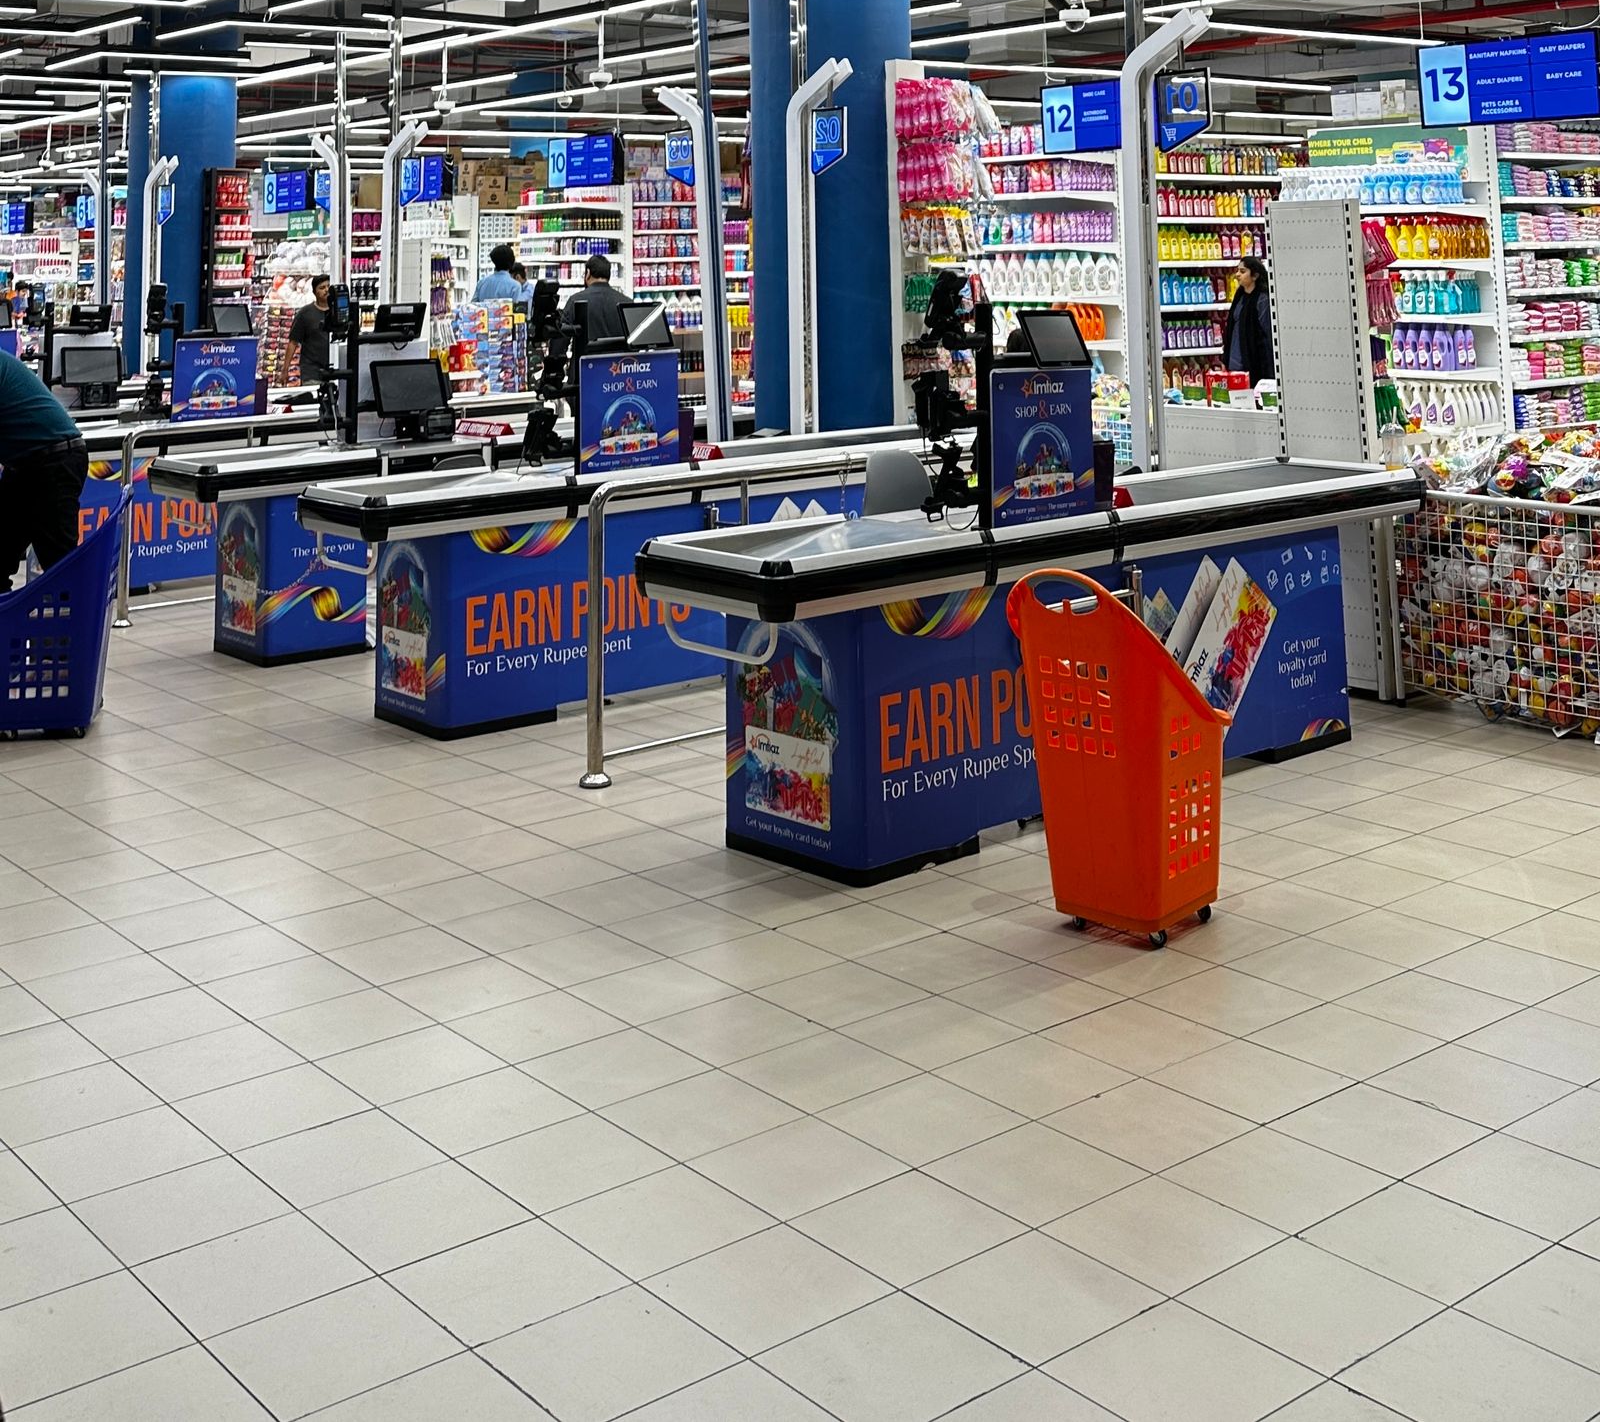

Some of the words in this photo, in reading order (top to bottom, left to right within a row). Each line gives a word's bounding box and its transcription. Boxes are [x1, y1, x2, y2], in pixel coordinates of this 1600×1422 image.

[1468, 50, 1498, 60] SANITARY
[1499, 48, 1527, 57] NAPKINS
[1558, 42, 1586, 51] DIAPERS
[1497, 76, 1523, 84] DIAPERS
[1545, 71, 1563, 80] BABY
[1565, 70, 1583, 78] CARE
[1094, 89, 1106, 97] CARE
[1424, 66, 1465, 103] 13
[1481, 101, 1496, 109] PETS
[1497, 99, 1514, 107] CARE
[1481, 106, 1522, 115] ACCESSORIES
[1046, 104, 1073, 133] 12
[1308, 139, 1331, 148] WHERE
[1332, 138, 1351, 146] YOUR
[1352, 137, 1373, 146] CHILD
[1309, 148, 1341, 157] COMFORT
[1342, 146, 1373, 156] MATTERS
[551, 152, 566, 174] 10
[266, 182, 275, 205] 8
[3, 209, 8, 228] 5
[78, 204, 84, 219] 6
[210, 344, 236, 354] Imtiaz
[193, 358, 212, 366] SHOP
[222, 357, 240, 365] EARN
[621, 362, 651, 374] Imtiaz
[602, 383, 624, 393] SHOP
[625, 376, 635, 392] &
[636, 378, 658, 390] EARN
[1033, 380, 1065, 394] Imtiaz
[1015, 405, 1038, 419] SHOP
[1038, 400, 1049, 419] &
[1050, 403, 1072, 416] EARN
[692, 445, 712, 459] PLEASE
[138, 543, 173, 558] Rupee
[176, 538, 208, 554] Spent
[291, 547, 310, 558] The
[338, 542, 355, 555] you
[466, 584, 561, 656] EARN
[1283, 639, 1300, 655] Get
[1301, 636, 1321, 653] your
[466, 658, 491, 677] For
[496, 653, 538, 672] Every
[544, 646, 587, 665] Rupee
[603, 634, 632, 655] pent
[1278, 657, 1306, 675] loyalty
[1308, 650, 1327, 667] card
[1291, 670, 1317, 690] today!
[880, 674, 981, 774] EARN
[758, 738, 780, 755] Imtiaz
[882, 779, 908, 802] For
[914, 766, 958, 793] Every
[964, 753, 1009, 779] Rupee
[745, 816, 757, 827] Get
[759, 819, 772, 832] your
[773, 822, 794, 841] loyalty
[795, 830, 810, 845] card
[811, 835, 831, 851] today!
